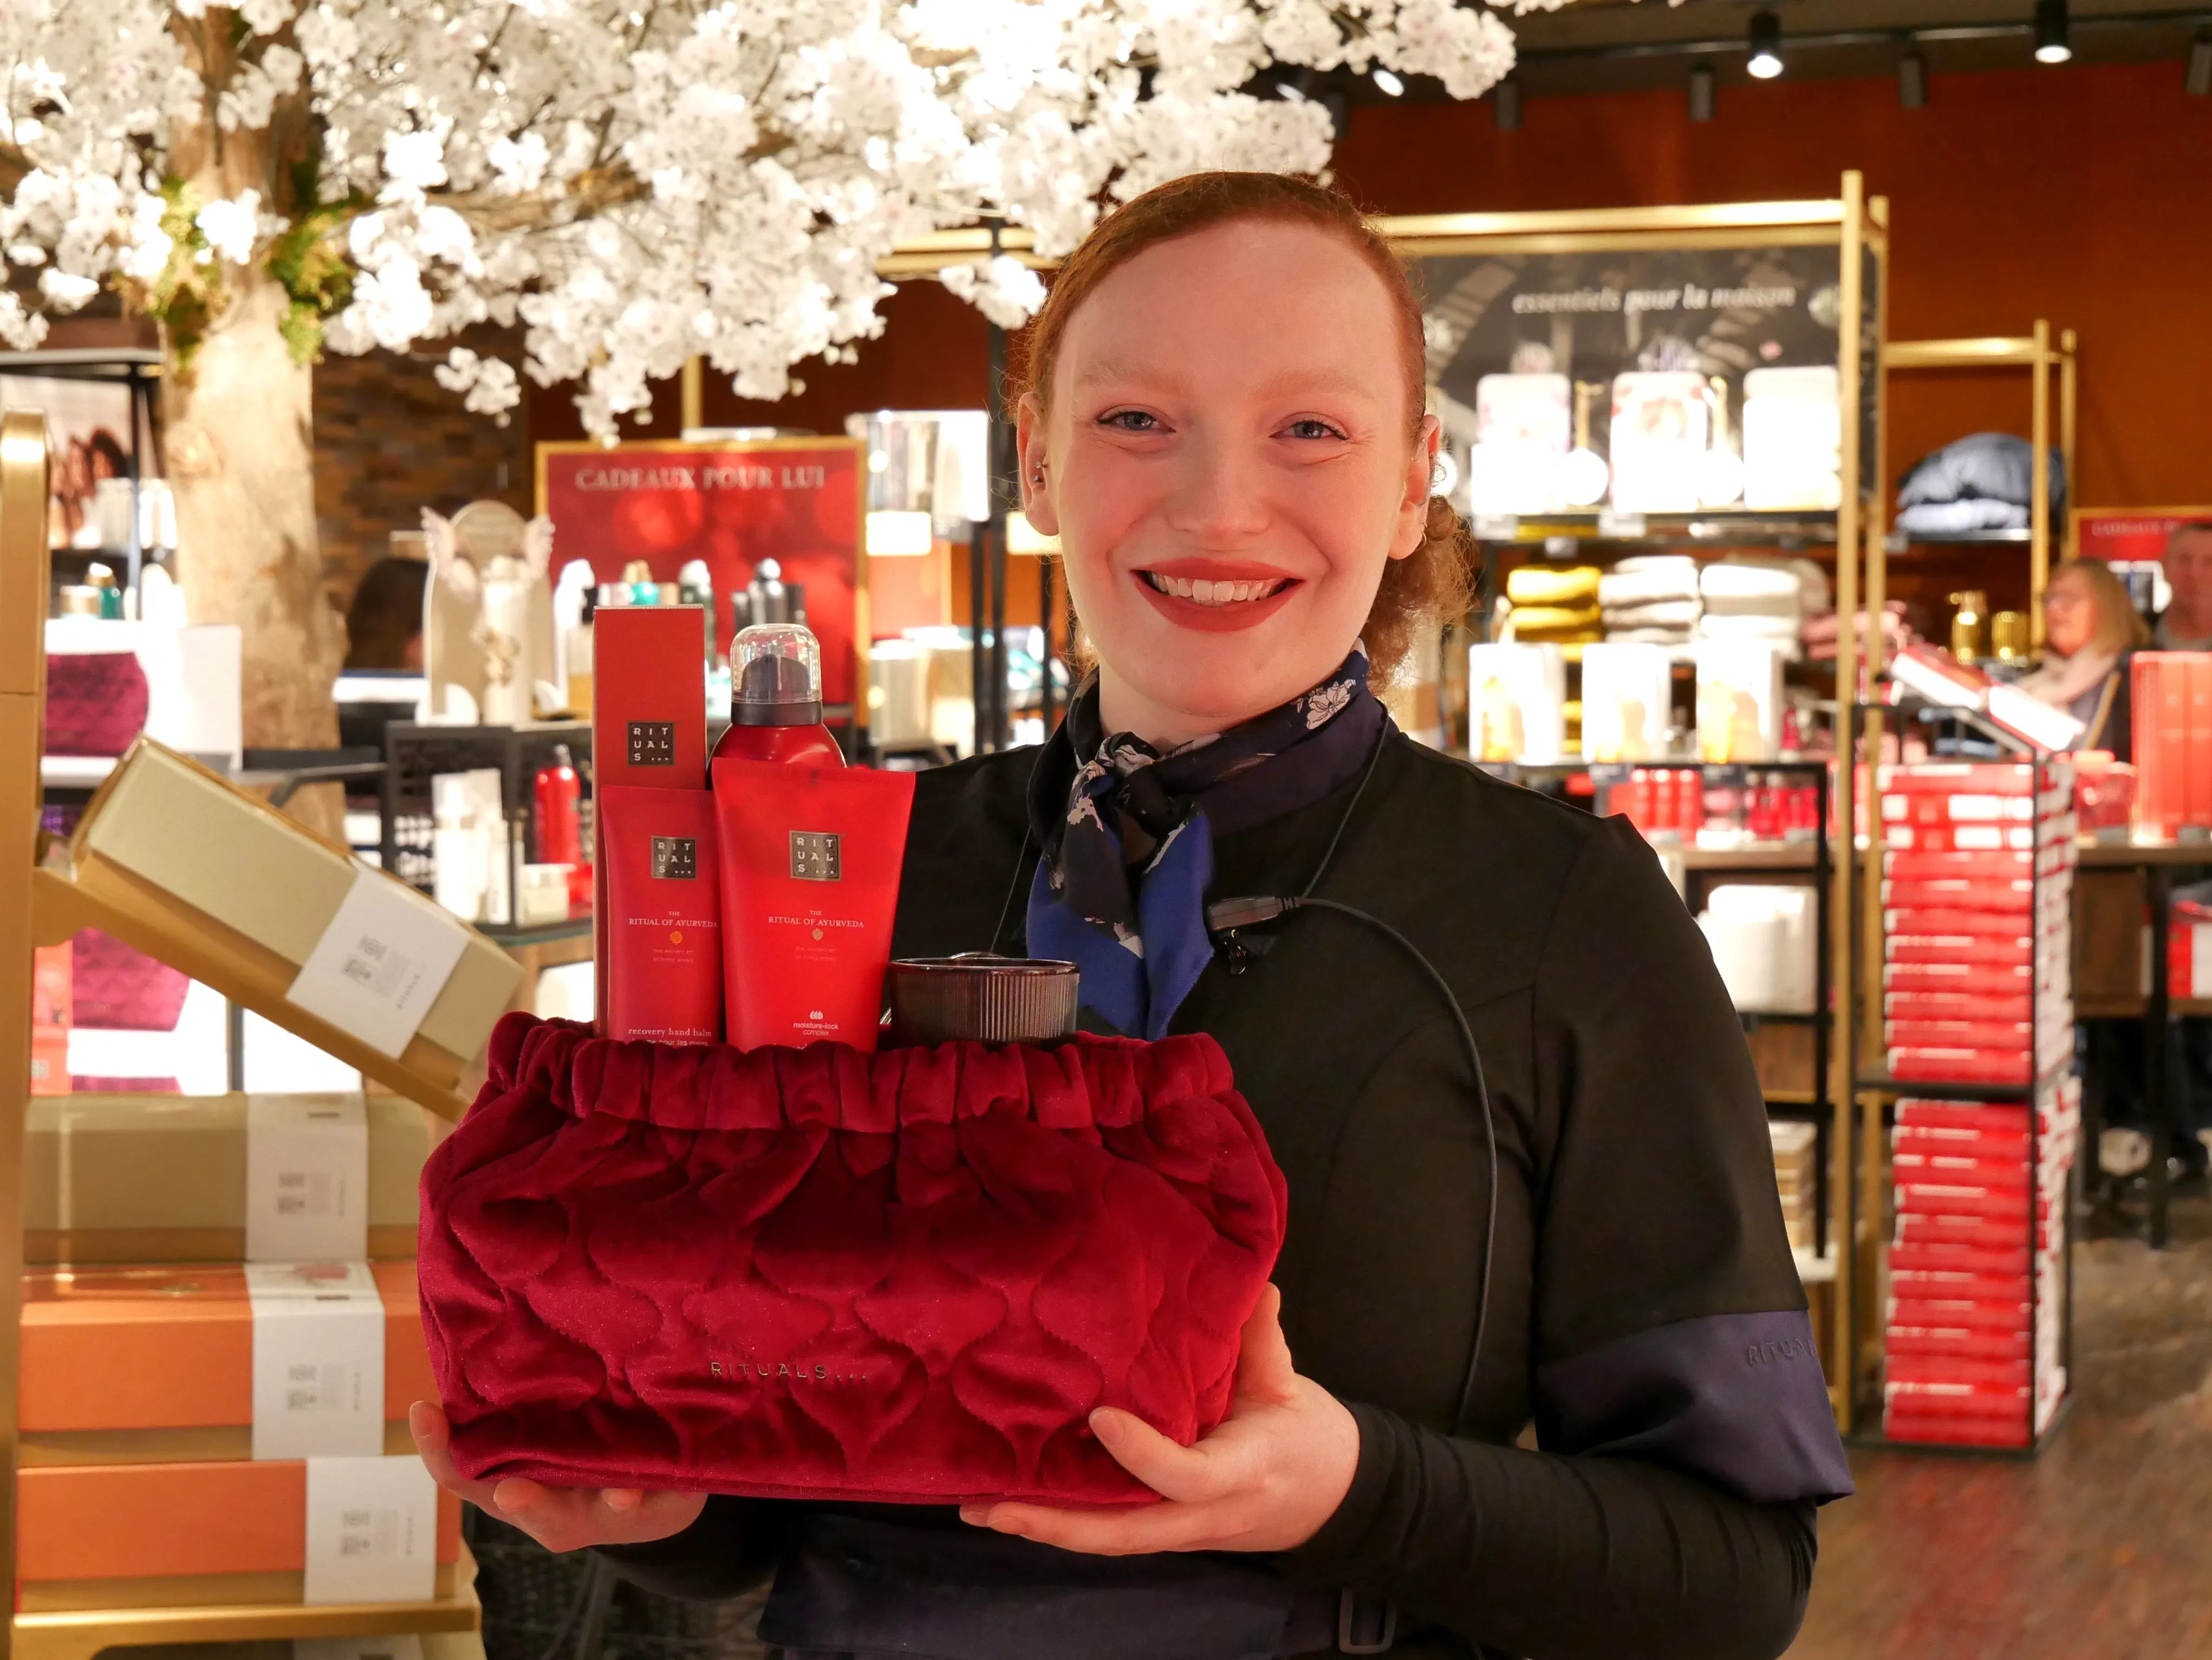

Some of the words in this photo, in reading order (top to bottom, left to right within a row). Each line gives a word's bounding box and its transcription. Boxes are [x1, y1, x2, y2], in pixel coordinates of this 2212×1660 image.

[1624, 290, 1680, 316] pour
[1683, 283, 1708, 309] la
[1711, 286, 1796, 308] maison
[575, 466, 695, 490] CADEAUX
[704, 466, 773, 490] POUR
[782, 466, 824, 489] LUI
[629, 918, 660, 926] RITUAL
[675, 920, 718, 928] AYURVEDA
[768, 916, 801, 925] RITUAL
[803, 918, 816, 926] OF
[818, 919, 864, 928] AYURVEDA
[793, 1022, 838, 1030] moisture-lock
[628, 1028, 666, 1038] recovery
[668, 1027, 691, 1036] hand
[693, 1028, 712, 1037] balm
